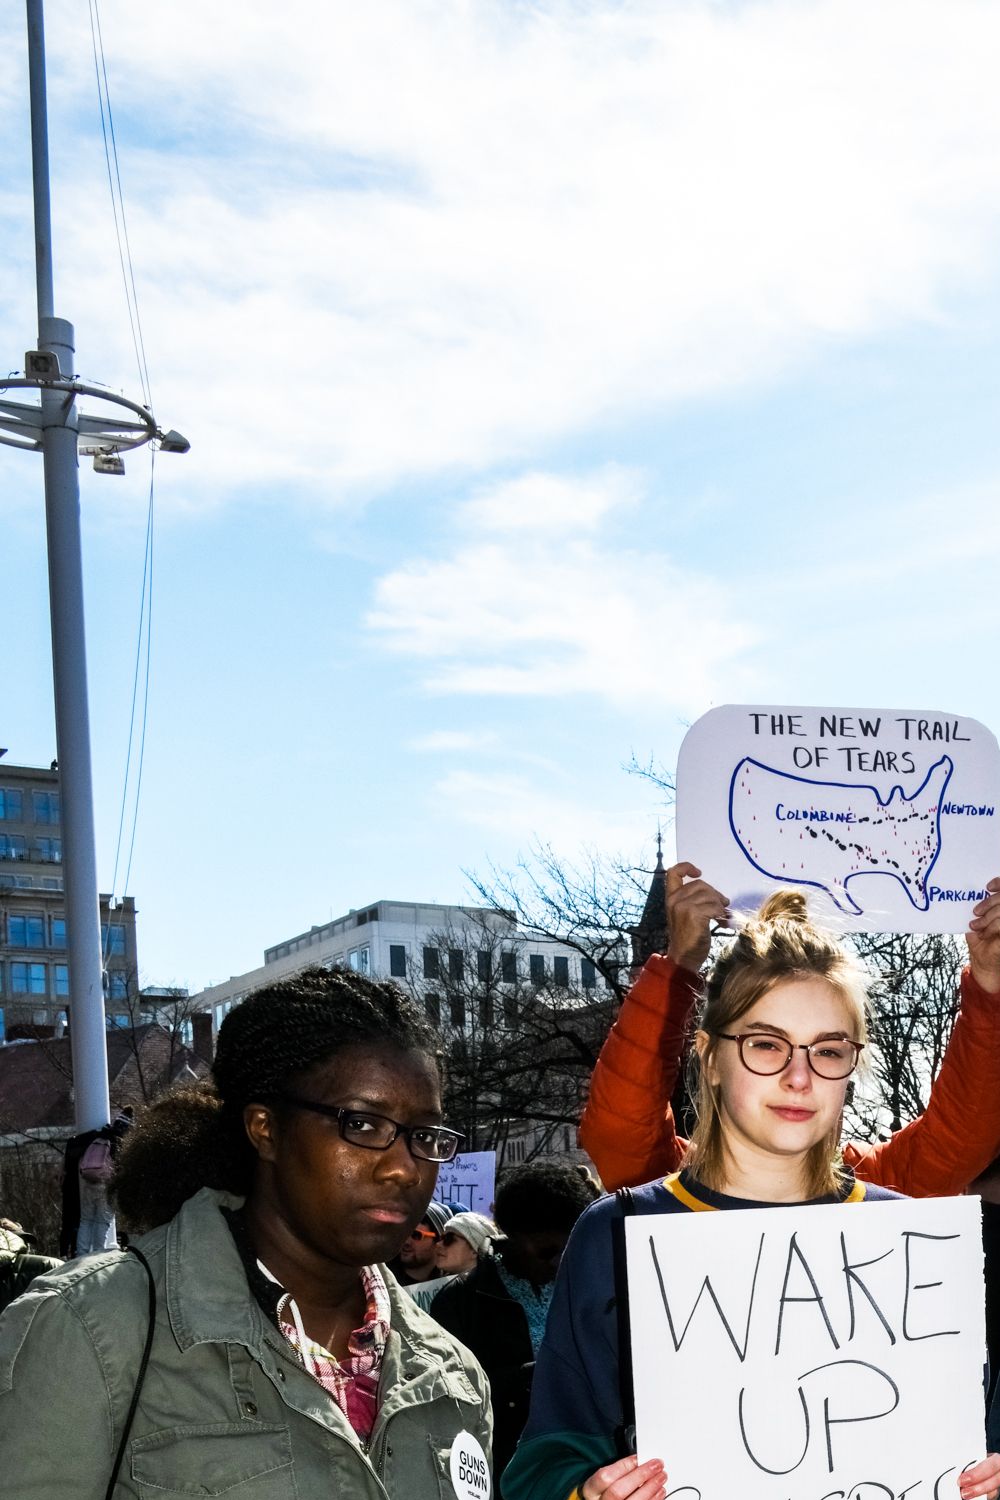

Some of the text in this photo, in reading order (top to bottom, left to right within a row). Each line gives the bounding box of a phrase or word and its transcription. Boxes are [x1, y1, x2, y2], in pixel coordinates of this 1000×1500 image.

[749, 713, 971, 743] THE NEW TRAIL
[793, 747, 916, 774] OF TEARS
[775, 803, 857, 824] COLUMBINE
[942, 801, 995, 816] NEWTOWN
[649, 1231, 961, 1362] WAKE
[739, 1359, 900, 1476] UP
[460, 1450, 486, 1475] GUNS
[459, 1466, 487, 1492] DOWN
